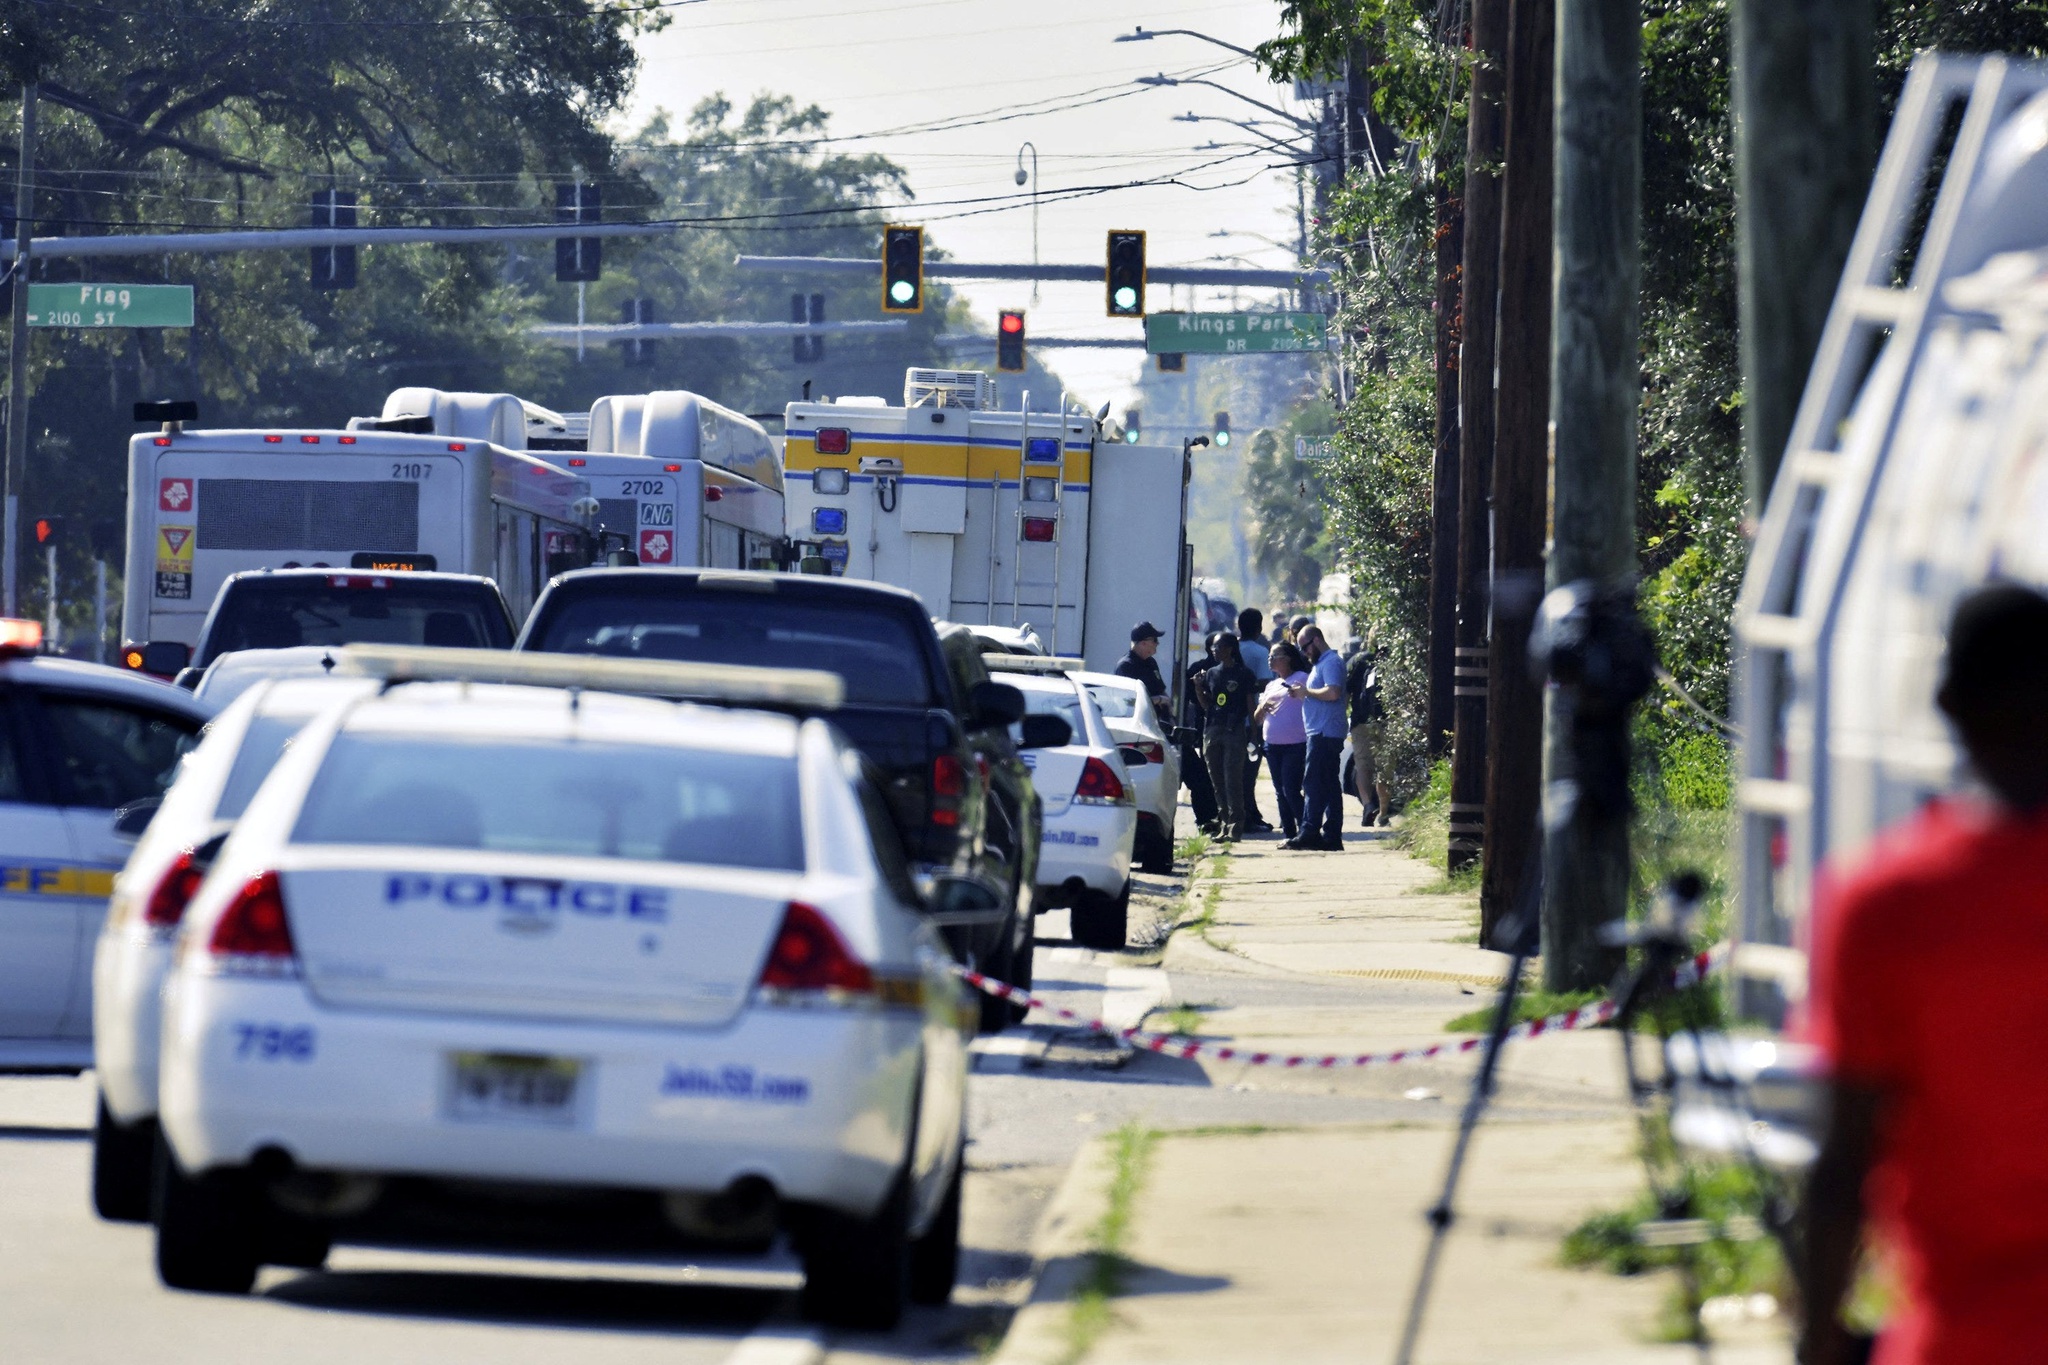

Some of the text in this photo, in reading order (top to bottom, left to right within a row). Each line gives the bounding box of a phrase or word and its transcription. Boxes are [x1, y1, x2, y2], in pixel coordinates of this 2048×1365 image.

[80, 286, 131, 310] Flag
[48, 311, 115, 325] 2100 ST
[1178, 314, 1295, 335] Kings Park
[1226, 338, 1247, 350] DR
[392, 463, 432, 479] 2107
[622, 480, 664, 495] 2702
[642, 504, 673, 525] CNG
[384, 872, 668, 924] POLICE
